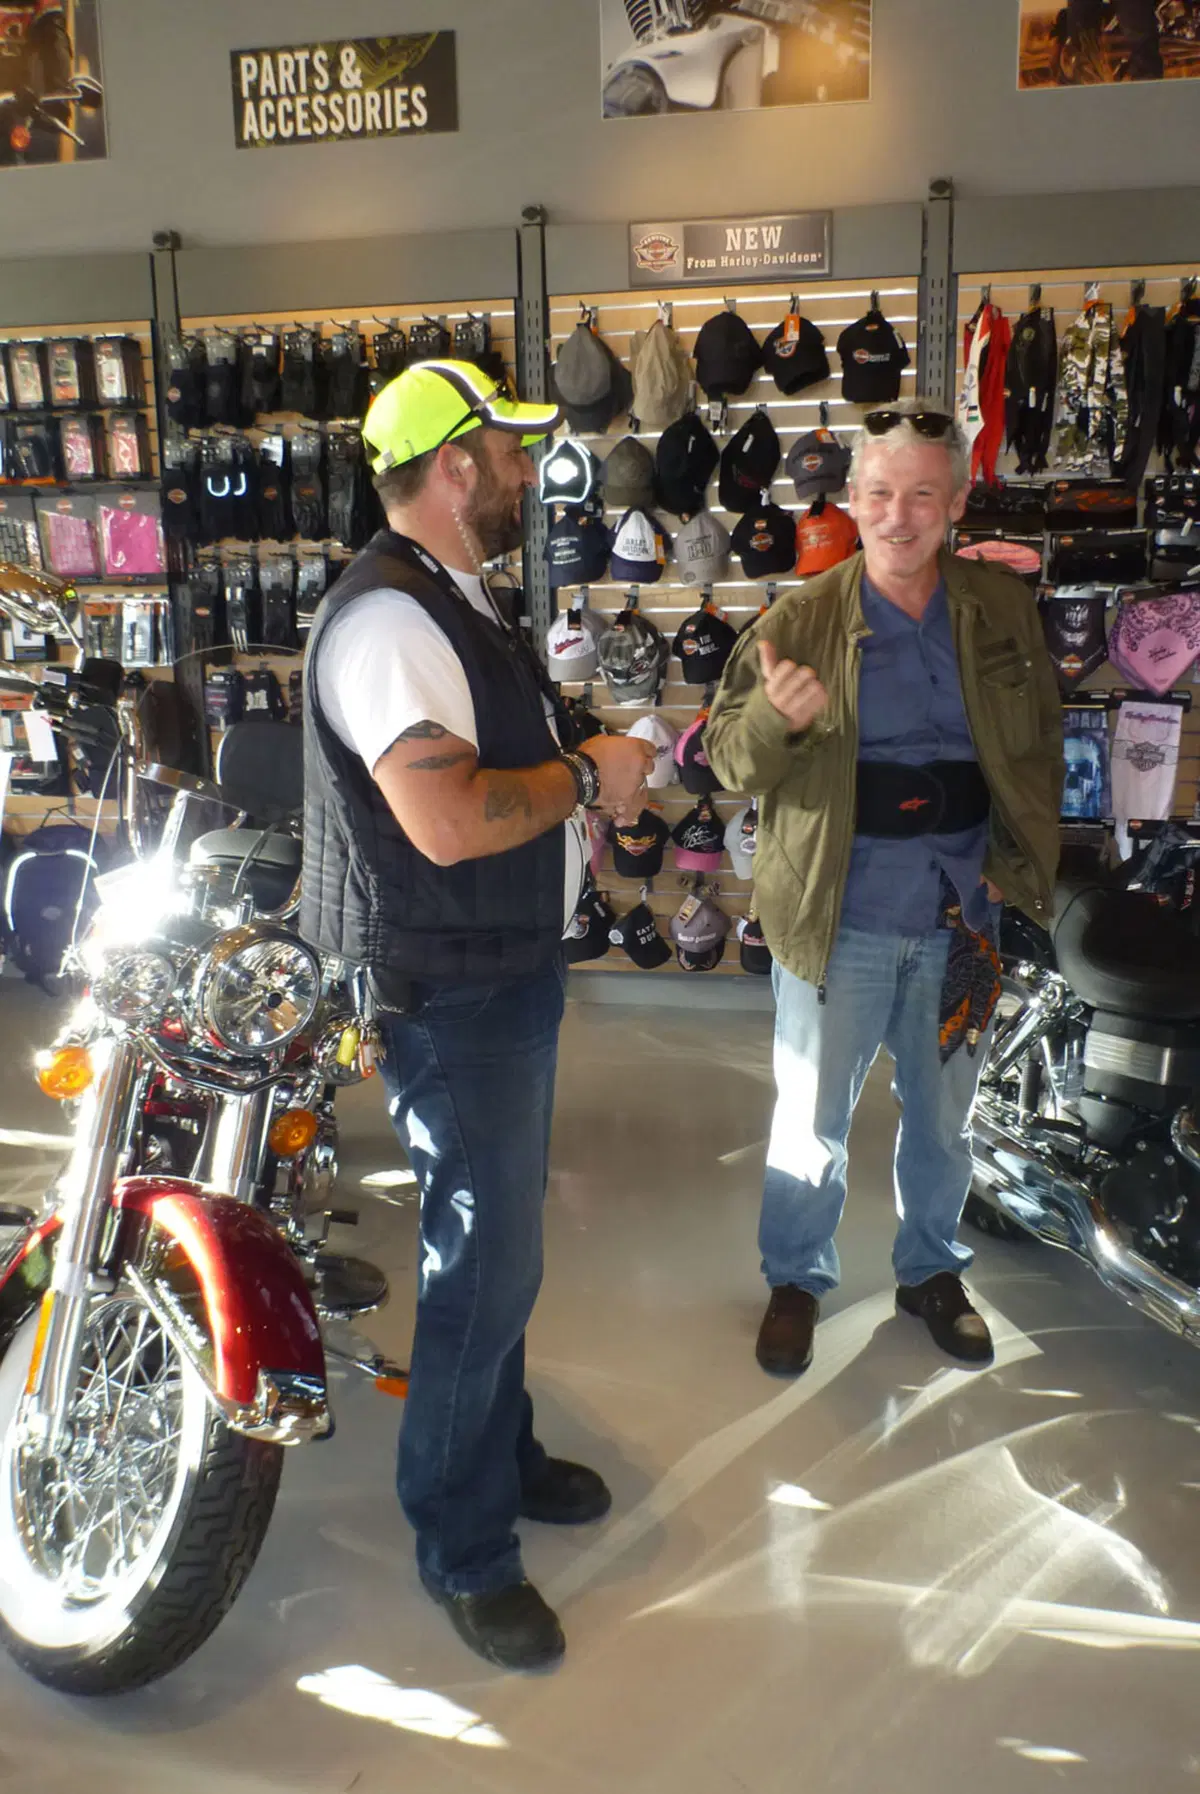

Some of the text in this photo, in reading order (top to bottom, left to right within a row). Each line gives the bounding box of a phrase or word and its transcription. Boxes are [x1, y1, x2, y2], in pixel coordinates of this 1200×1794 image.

[240, 46, 363, 98] PARTS &
[243, 85, 428, 141] ACCESSORIES
[725, 225, 782, 251] NEW
[687, 256, 716, 269] From
